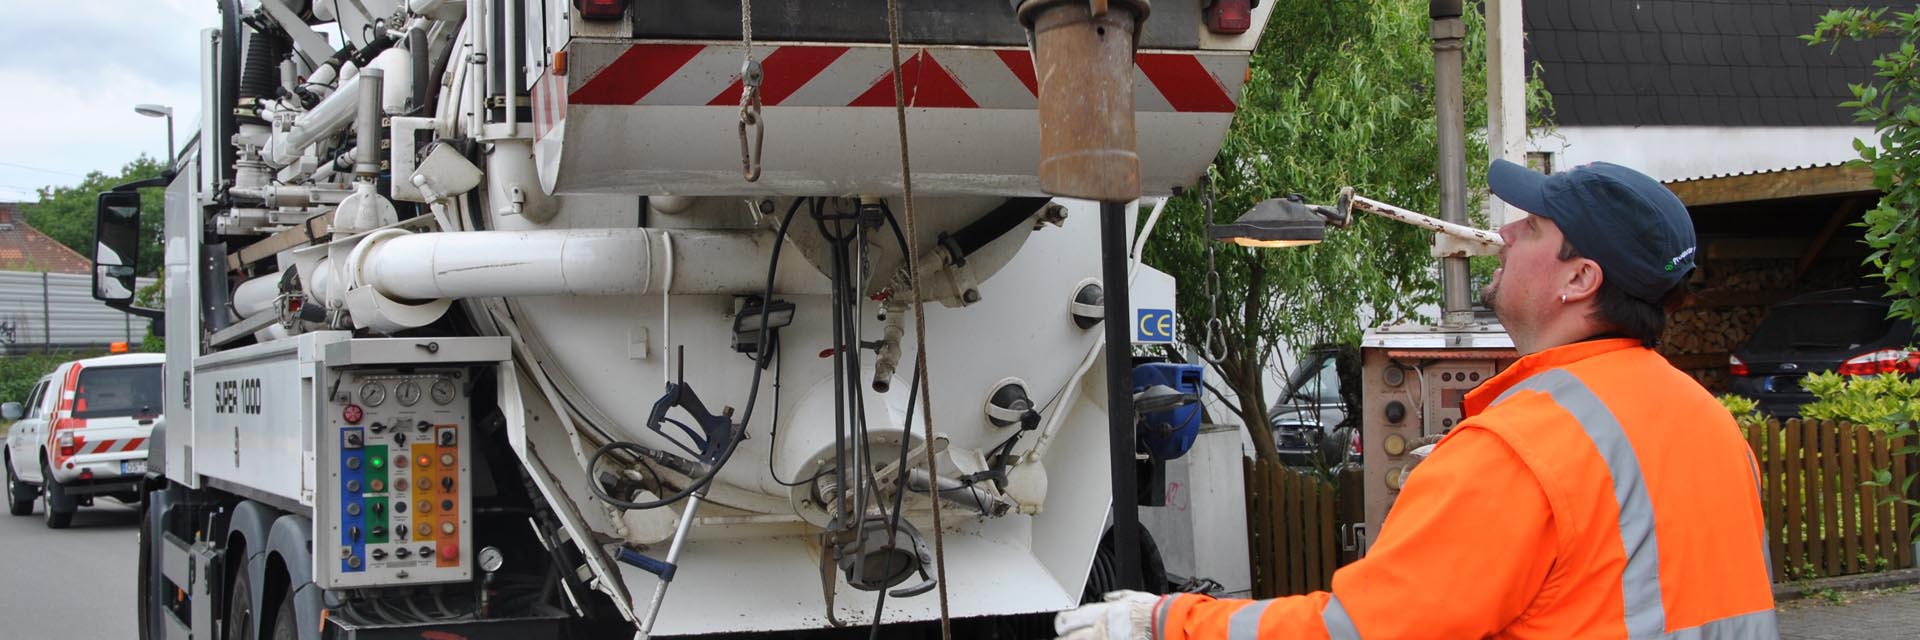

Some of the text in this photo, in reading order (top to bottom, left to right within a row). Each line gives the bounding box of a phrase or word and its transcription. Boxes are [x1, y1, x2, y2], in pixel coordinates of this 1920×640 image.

[1140, 313, 1170, 337] CE
[215, 378, 261, 414] SUPER 1000
